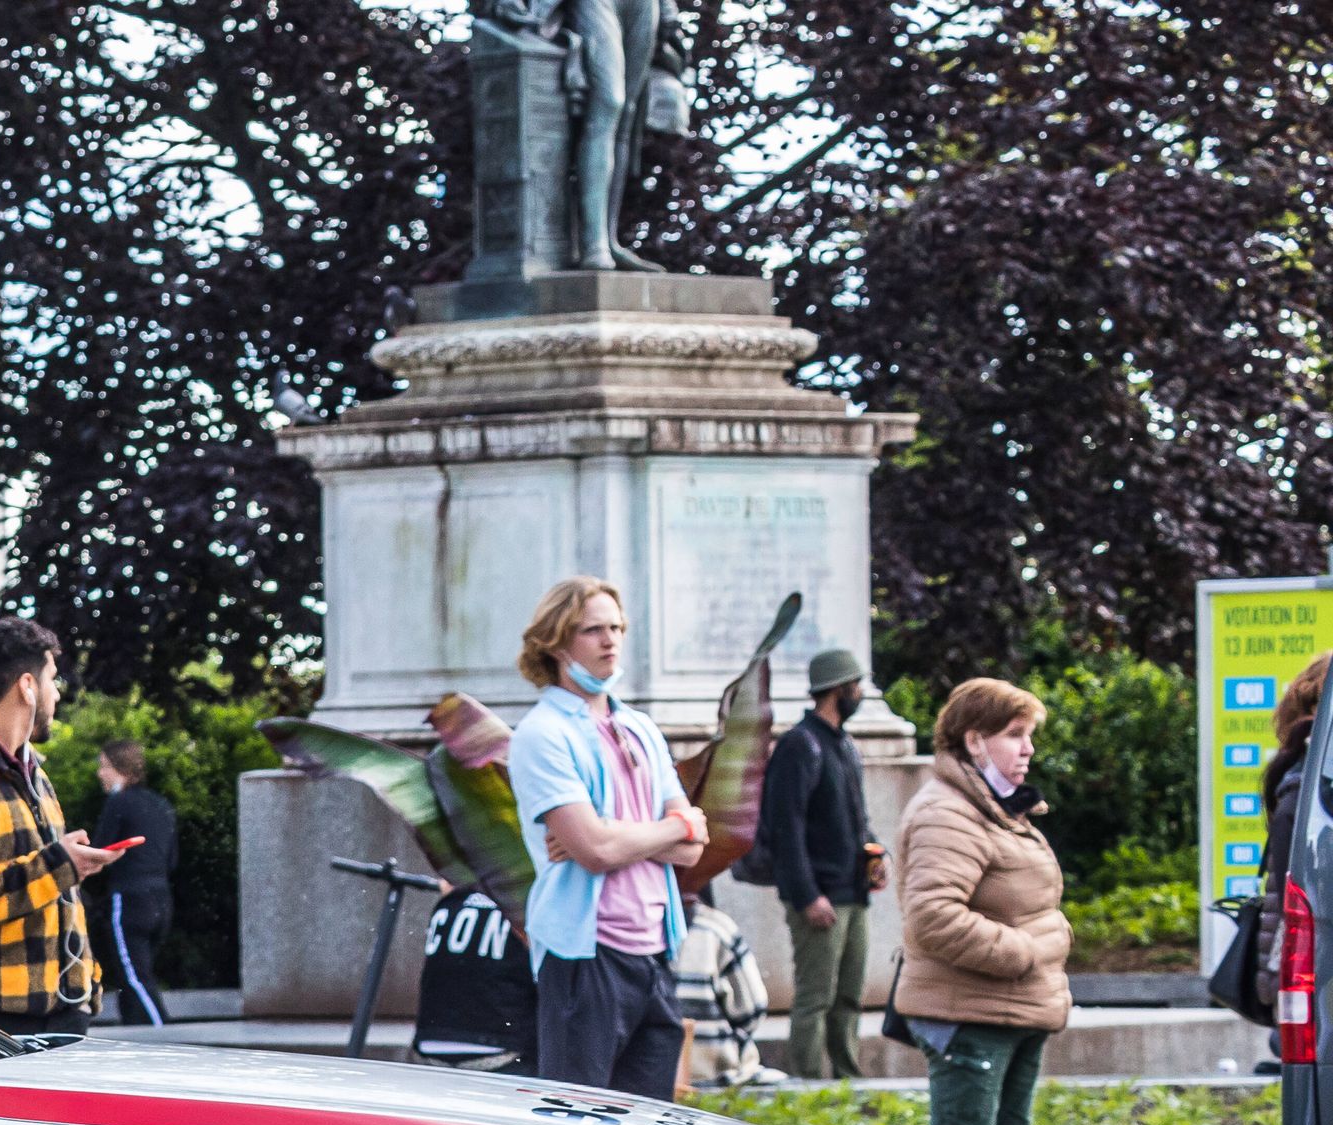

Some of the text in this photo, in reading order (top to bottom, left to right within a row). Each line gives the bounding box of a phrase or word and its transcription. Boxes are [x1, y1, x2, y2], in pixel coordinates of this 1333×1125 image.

[1224, 605, 1317, 627] VOTATION DU
[1224, 634, 1314, 657] 13 JUIN 2021
[1236, 682, 1264, 705] OUI
[424, 906, 511, 960] CON
